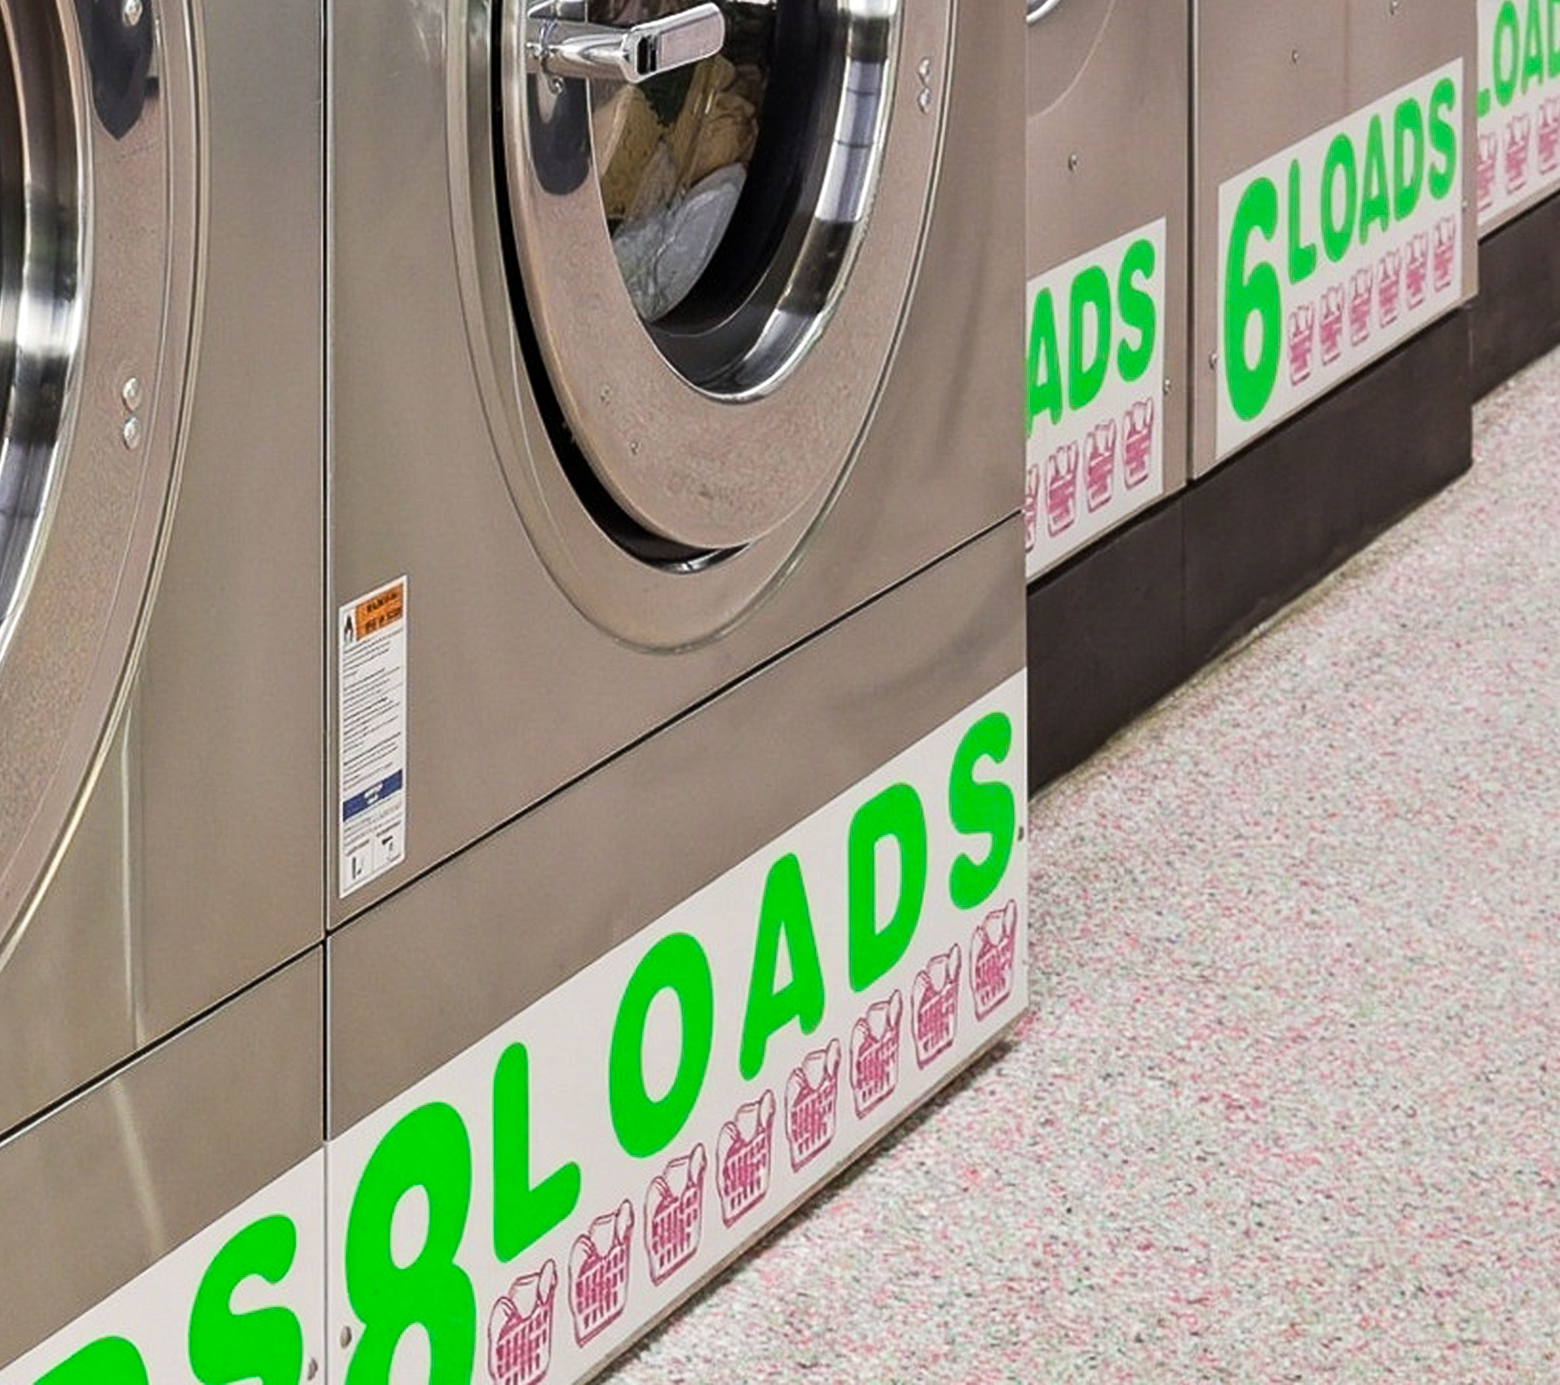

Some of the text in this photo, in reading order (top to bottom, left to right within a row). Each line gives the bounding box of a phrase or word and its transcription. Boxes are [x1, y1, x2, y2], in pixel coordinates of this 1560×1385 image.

[1224, 77, 1458, 422] 6 LOADS
[344, 1101, 478, 1385] 8
[492, 711, 1018, 1263] LOADS
